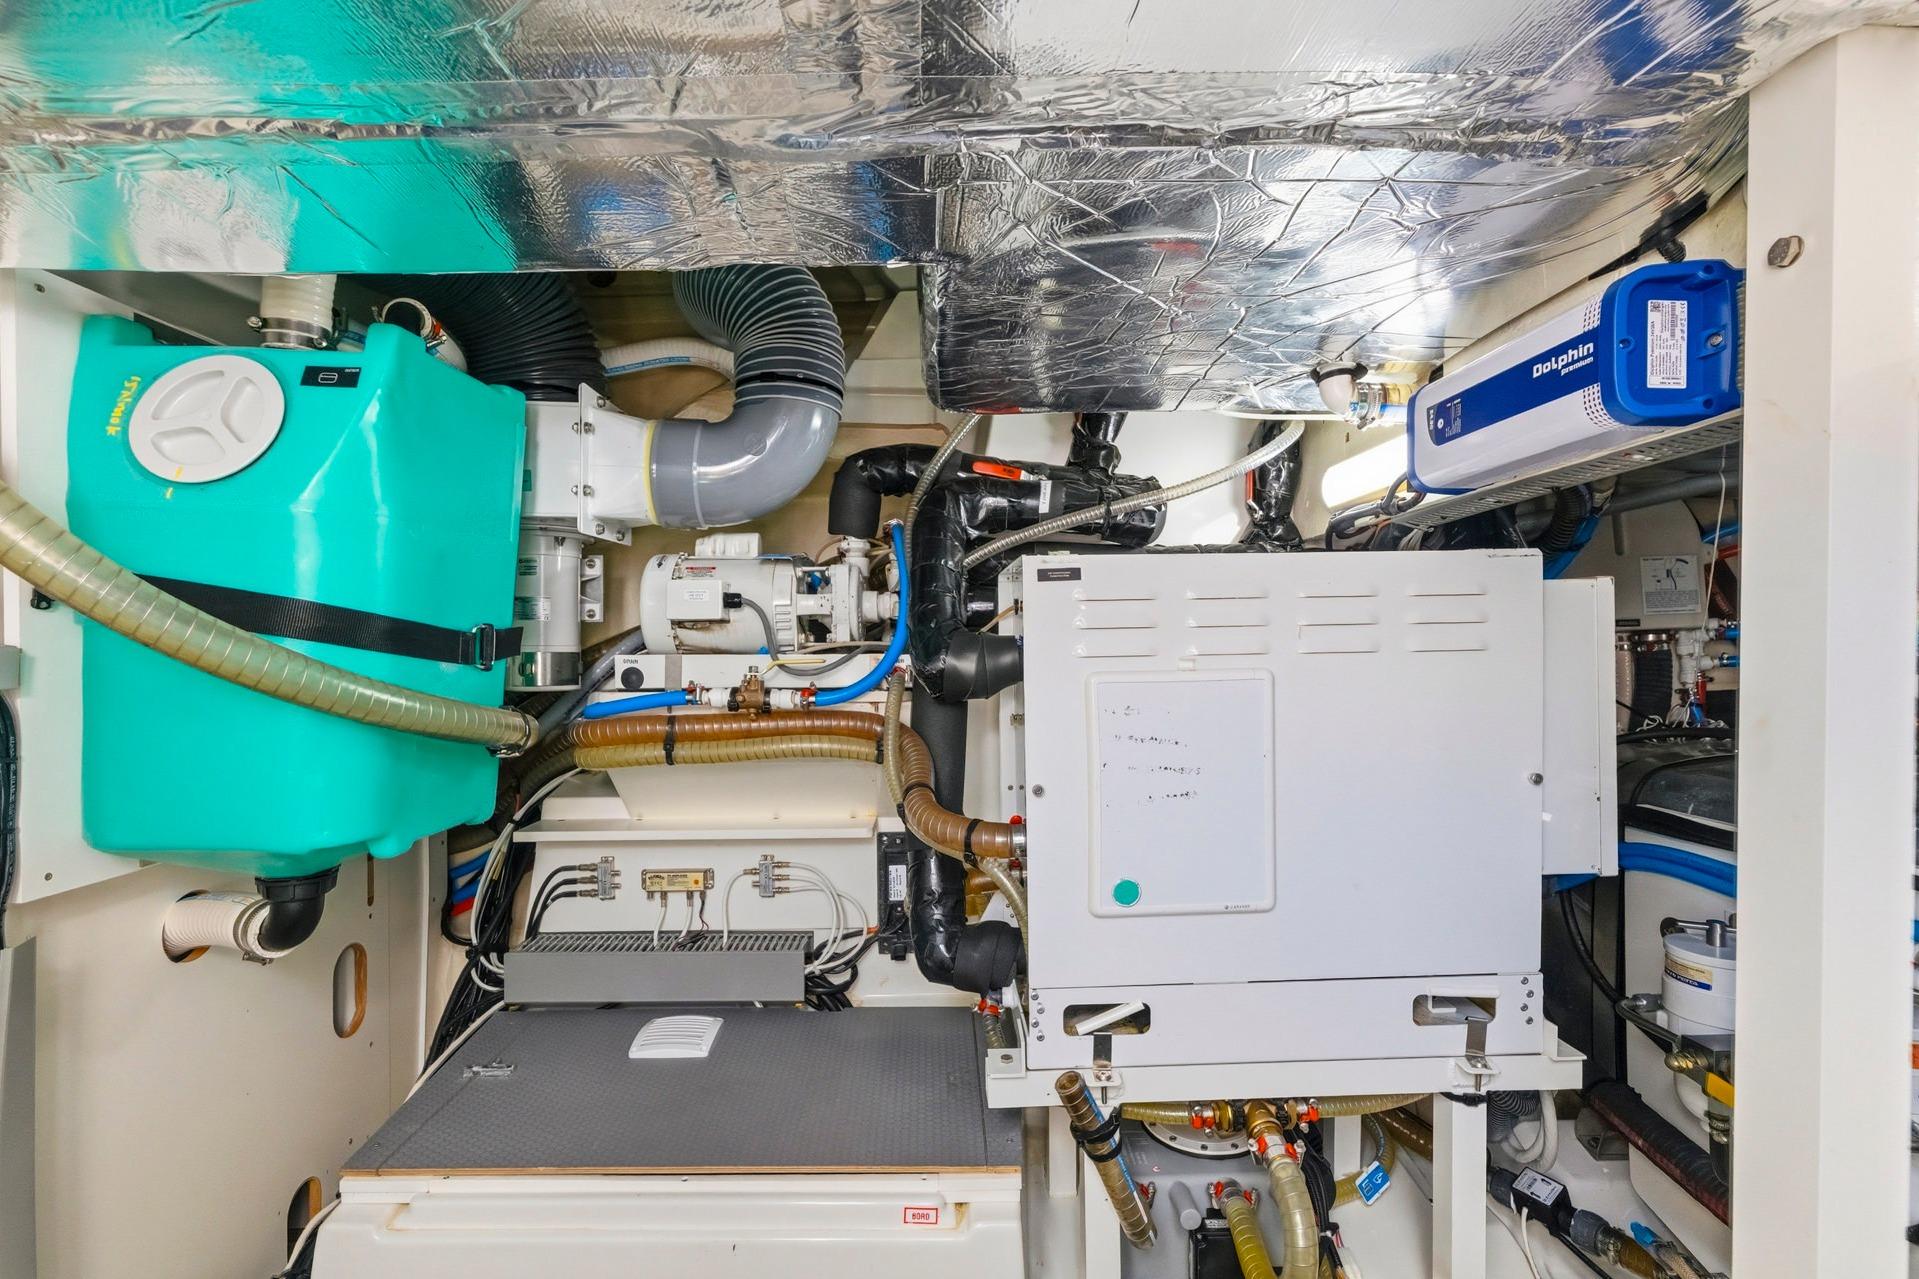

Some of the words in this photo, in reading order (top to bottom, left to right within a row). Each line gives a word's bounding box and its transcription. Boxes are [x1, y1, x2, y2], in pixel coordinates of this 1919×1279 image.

[1532, 342, 1594, 378] Dolphin
[1560, 356, 1594, 376] premium
[912, 1212, 929, 1220] BORD
